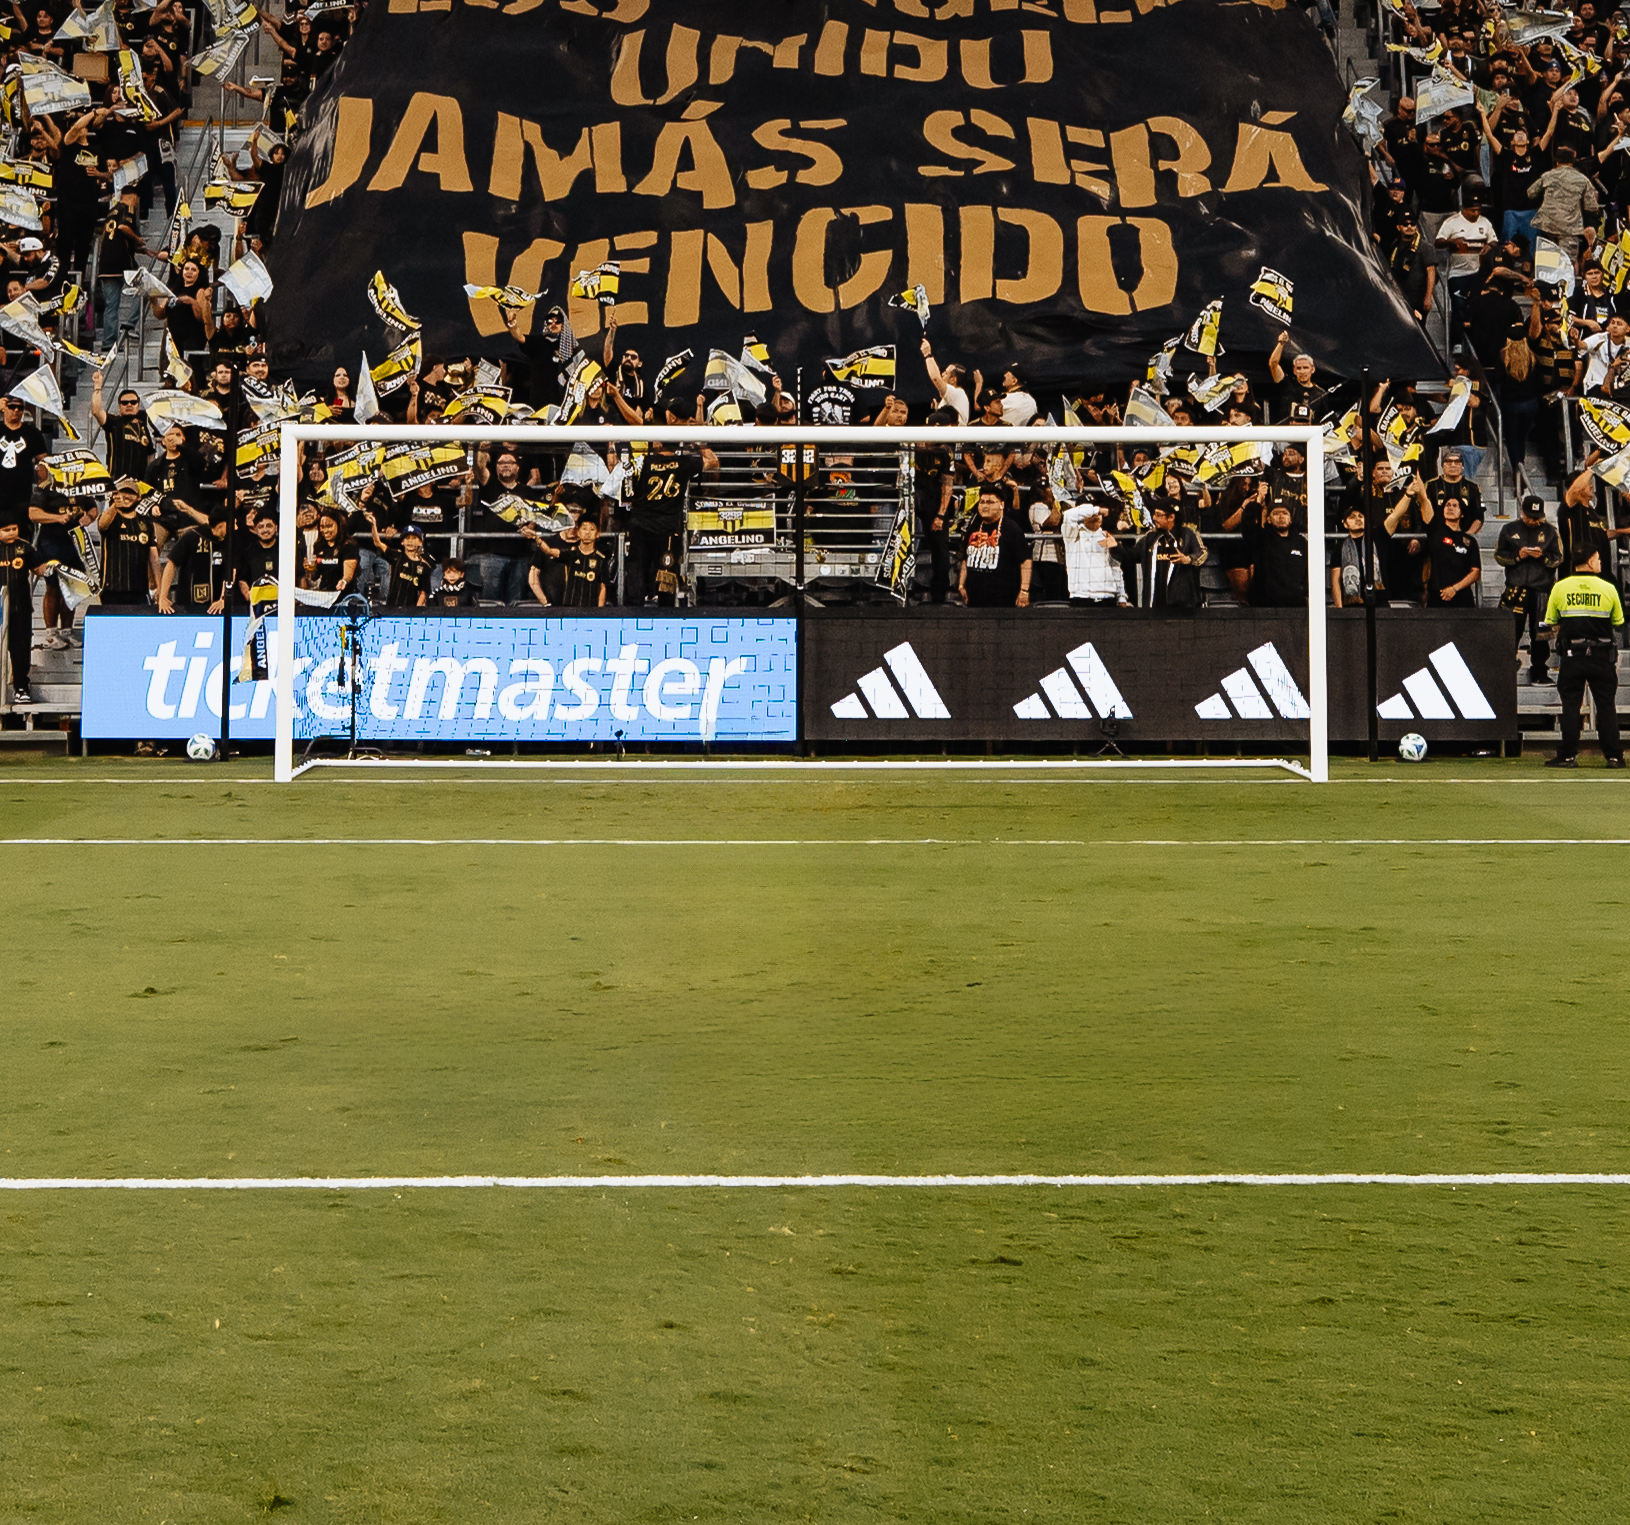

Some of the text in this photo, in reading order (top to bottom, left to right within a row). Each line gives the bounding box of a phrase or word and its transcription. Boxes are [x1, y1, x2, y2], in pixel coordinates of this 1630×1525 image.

[307, 92, 1329, 212] JAMÁS SERÁ
[461, 204, 1177, 340] VENCIDO
[401, 463, 459, 490] ANGELINO
[647, 473, 680, 501] 26
[700, 533, 765, 546] ANGELINO
[1566, 593, 1602, 607] SECURITY
[142, 631, 748, 723] ticketmaster
